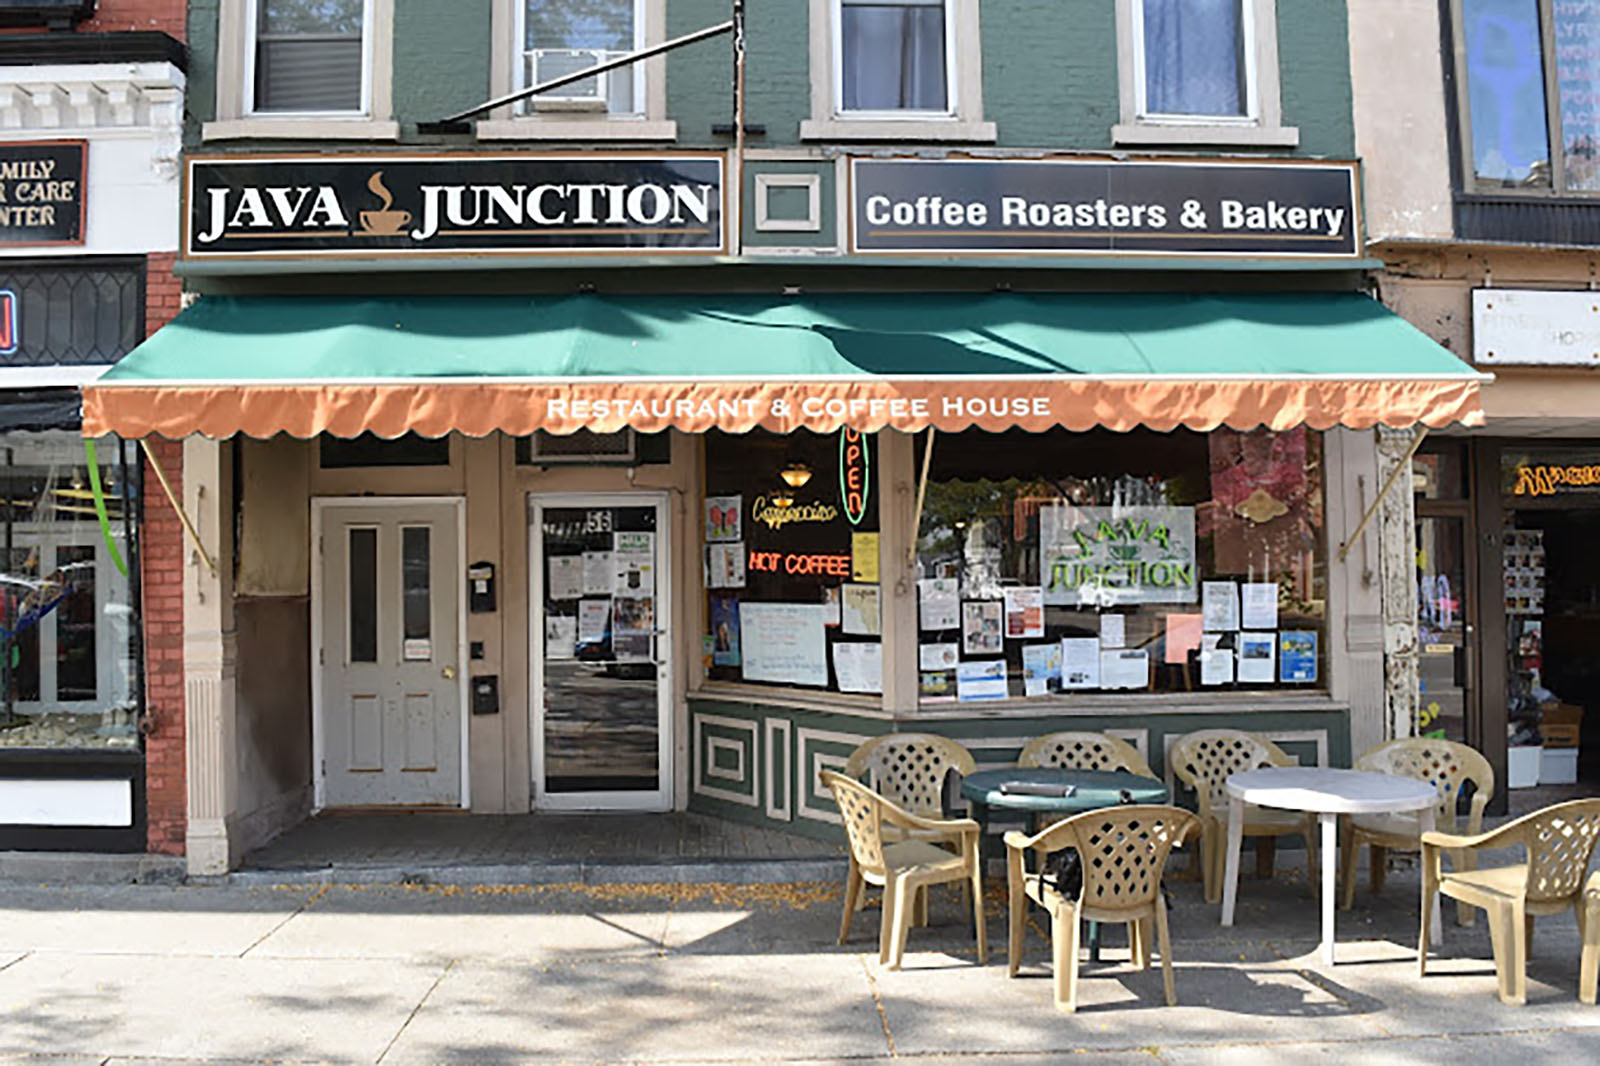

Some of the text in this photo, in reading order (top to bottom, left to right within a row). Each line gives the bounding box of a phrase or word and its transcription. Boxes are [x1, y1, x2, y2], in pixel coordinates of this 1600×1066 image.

[0, 160, 55, 179] MILY
[15, 181, 75, 202] CARE
[198, 183, 711, 242] JAVA JUNCTION
[866, 195, 1345, 236] Coffee Roasters & Bakery
[547, 396, 1051, 420] RESTAURANT & COFFEE HOUSE
[845, 427, 862, 514] OPEN
[1073, 518, 1171, 559] JAVA
[749, 552, 782, 572] HOT
[785, 554, 851, 577] COFFEE
[1049, 560, 1194, 593] JUNCTION
